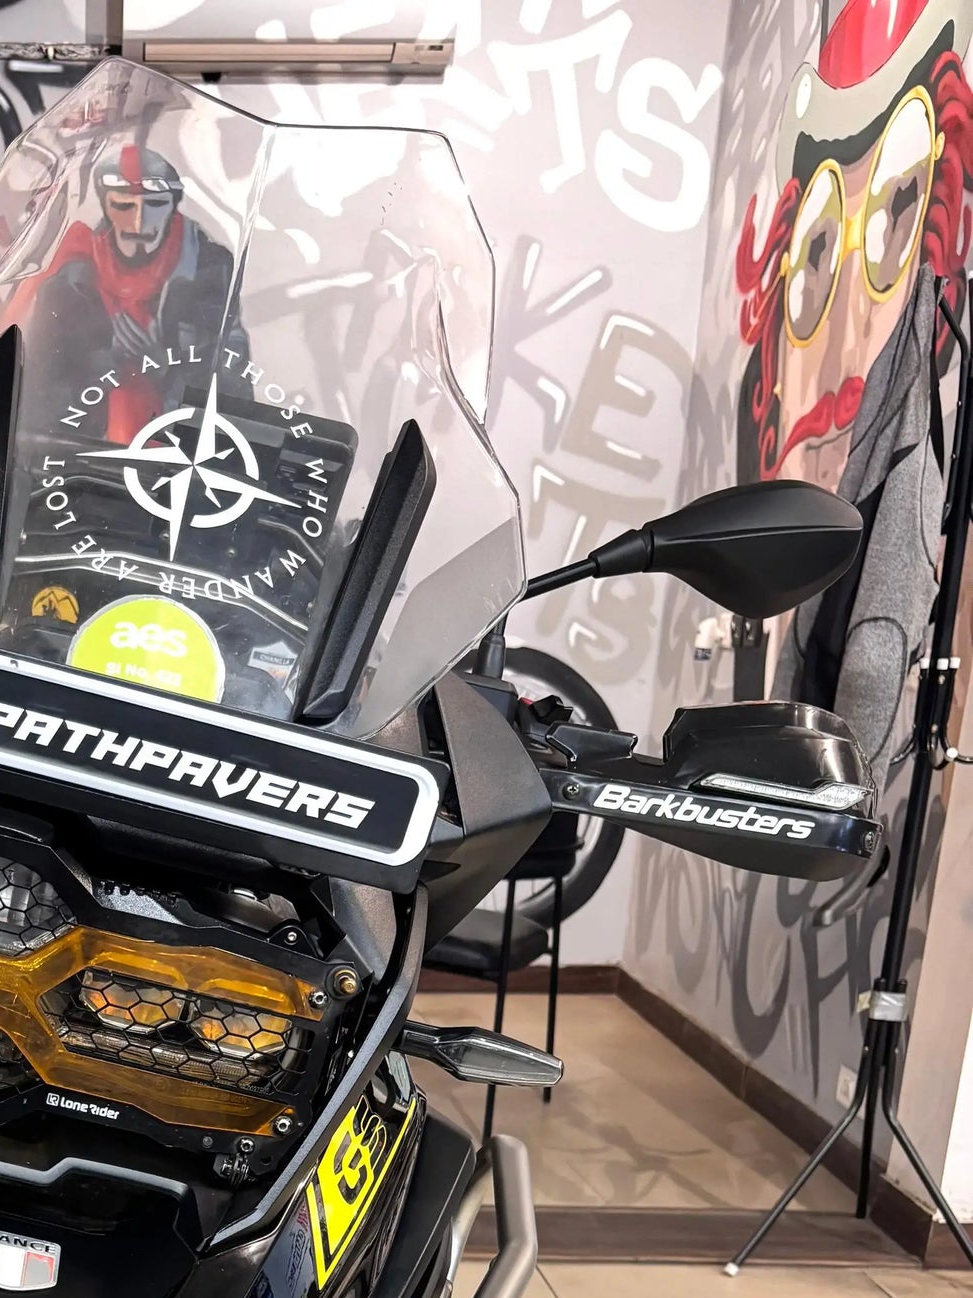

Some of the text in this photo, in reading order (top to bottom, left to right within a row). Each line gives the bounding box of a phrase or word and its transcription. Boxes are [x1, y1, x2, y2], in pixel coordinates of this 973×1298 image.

[42, 345, 328, 600] NOT ALL THOSE WHO WANDER ARE LOST
[109, 621, 188, 658] aes
[593, 783, 816, 840] Barkbusters
[89, 1103, 120, 1120] Rider
